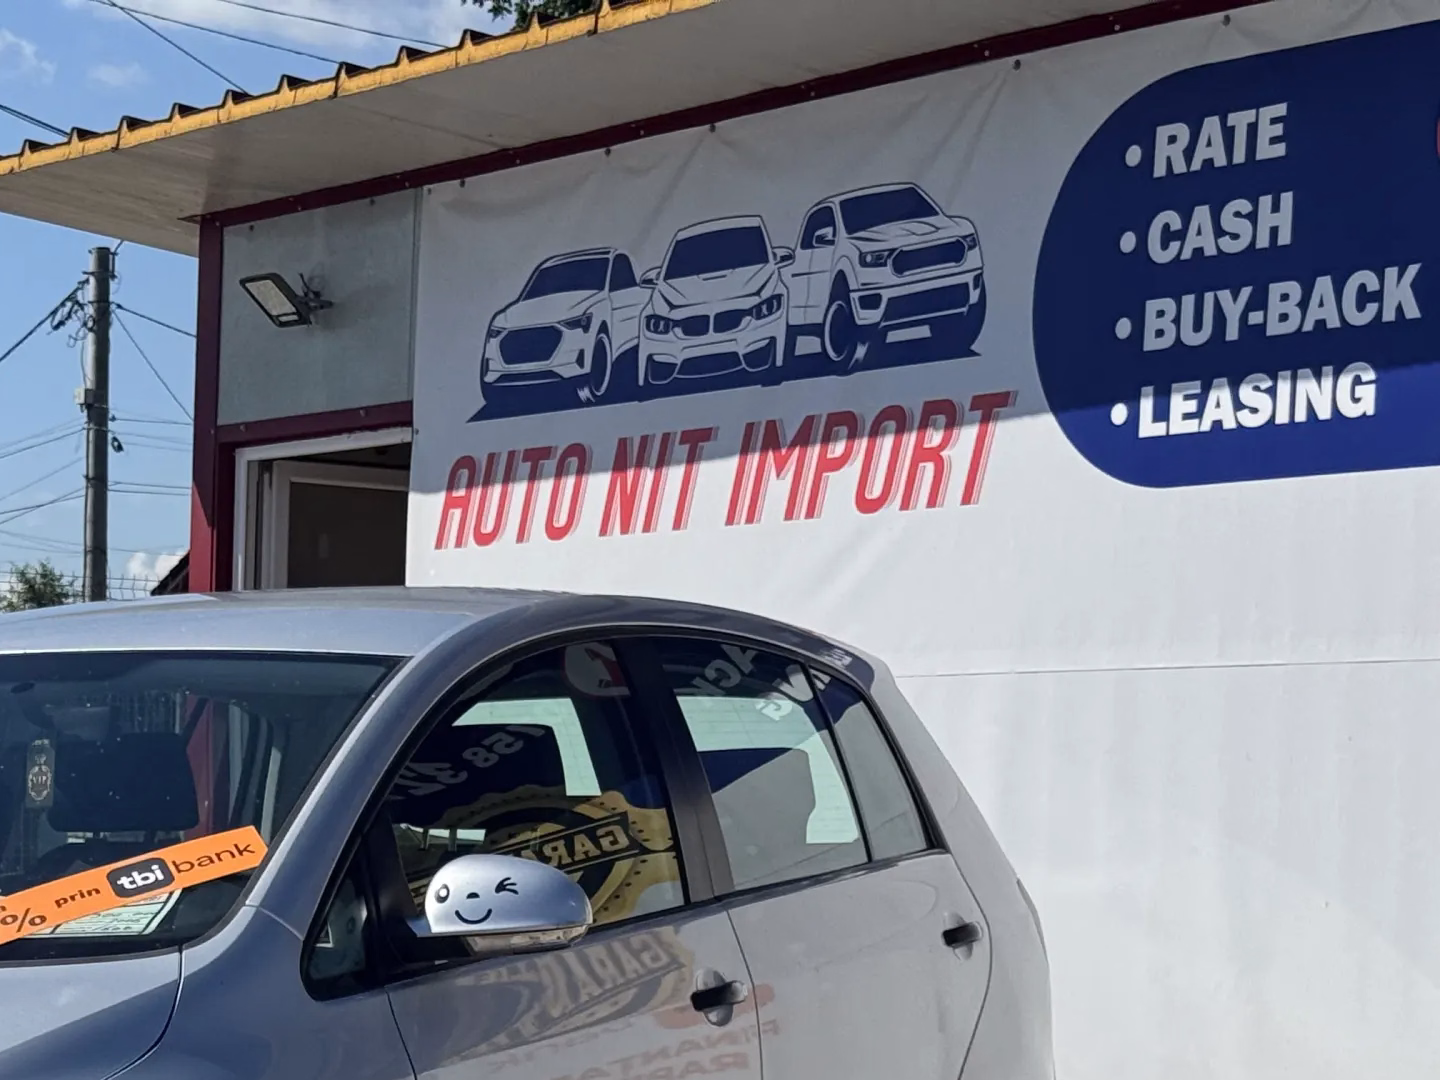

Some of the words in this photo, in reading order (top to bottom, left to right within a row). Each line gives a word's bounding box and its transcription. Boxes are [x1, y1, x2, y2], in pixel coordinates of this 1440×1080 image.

[1153, 103, 1289, 177] RATE
[1146, 191, 1293, 264] CASH
[1142, 262, 1422, 353] BUY-BACK
[1136, 363, 1378, 440] LEASING
[435, 442, 593, 551] AUTO
[598, 426, 719, 538] NIT
[725, 391, 1018, 527] IMPORT
[54, 887, 101, 909] prin
[116, 864, 166, 890] tbi
[172, 842, 256, 875] bank
